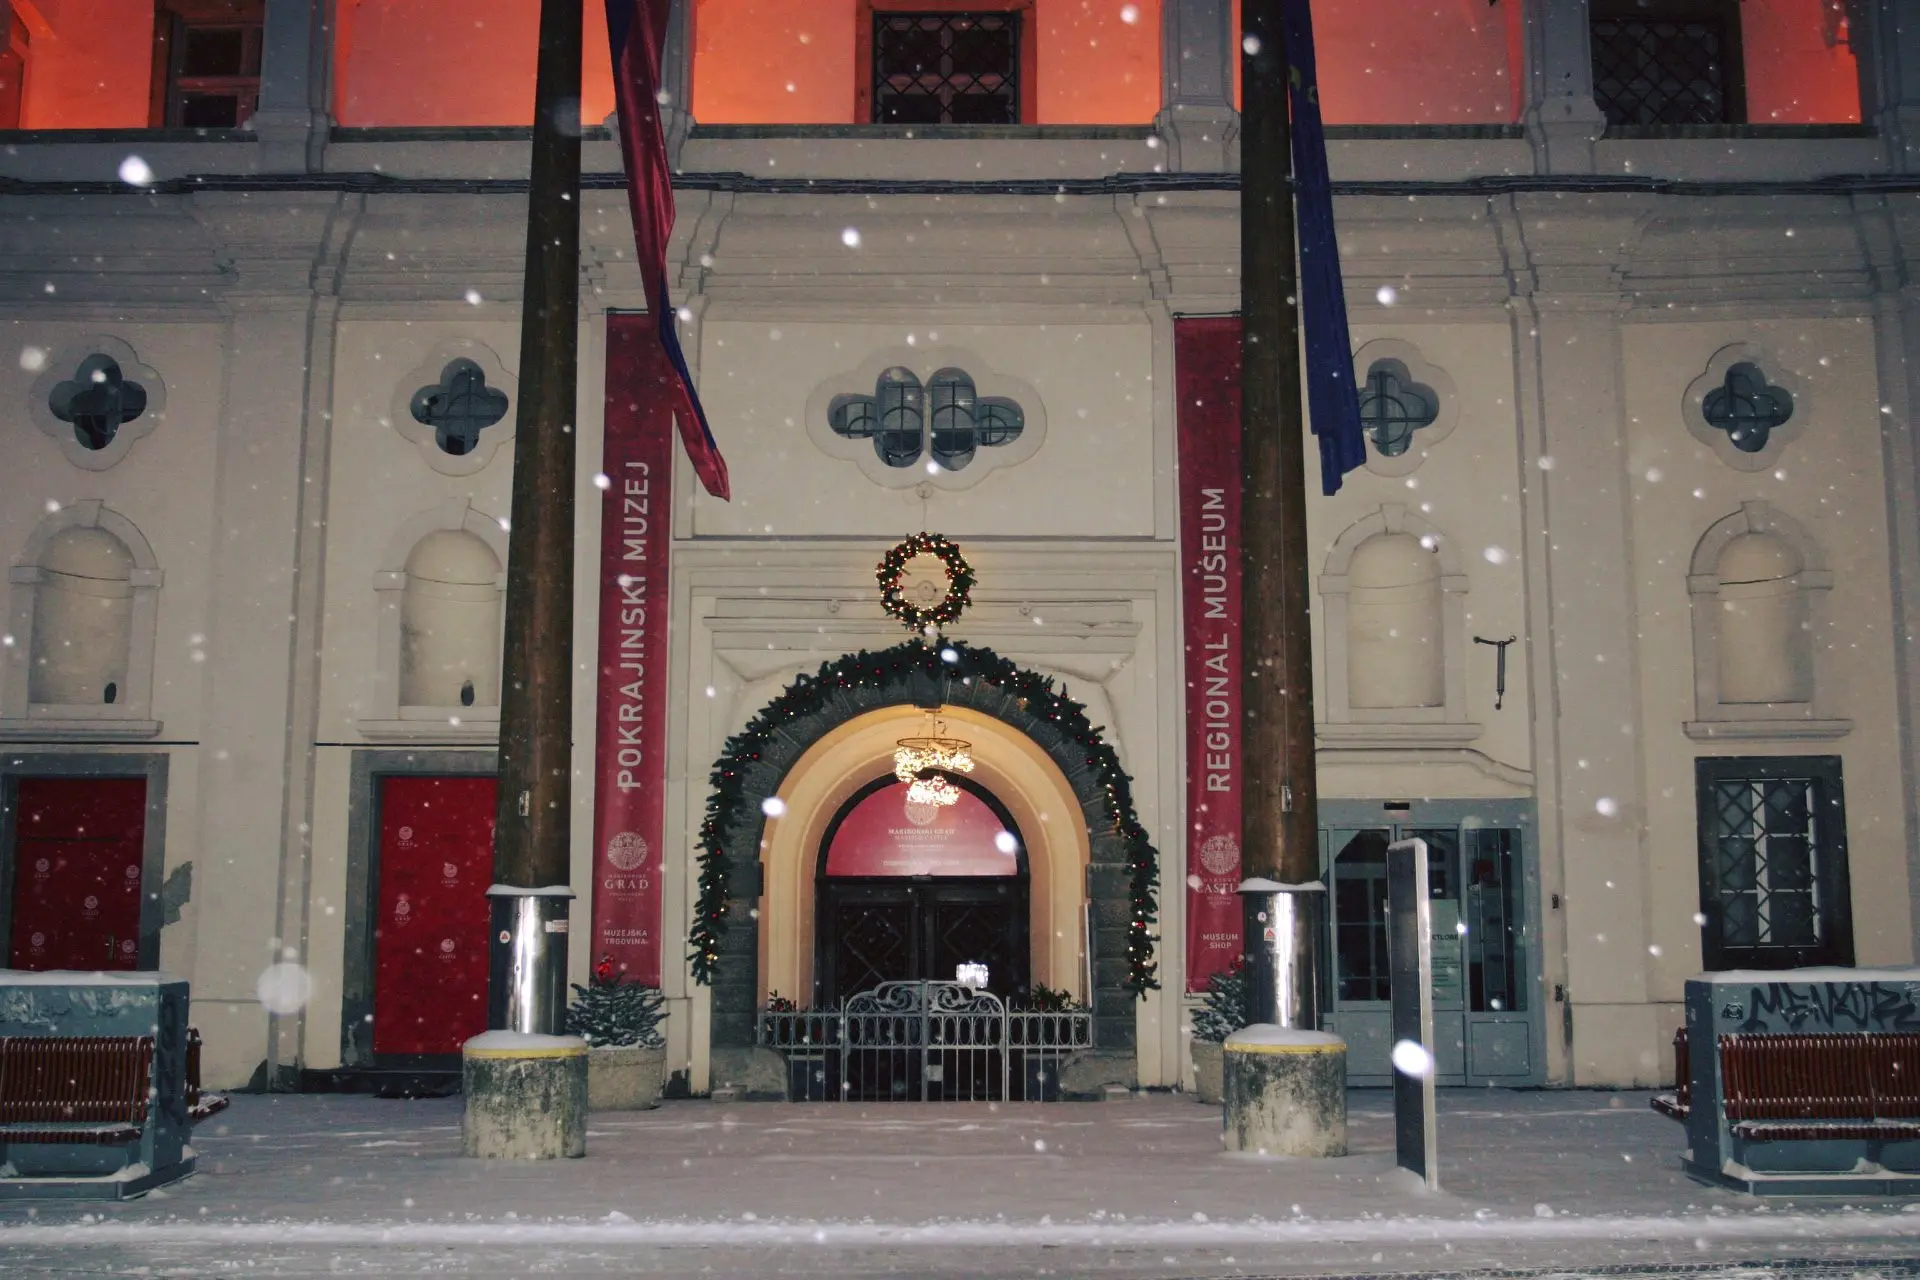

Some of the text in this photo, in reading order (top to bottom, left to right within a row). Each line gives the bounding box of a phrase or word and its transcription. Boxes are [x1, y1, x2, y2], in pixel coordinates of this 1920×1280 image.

[617, 461, 649, 789] POKRAJINSKI MUZEJ
[1202, 487, 1230, 792] REGIONAL MUSEUM
[604, 879, 649, 890] GRAD
[603, 929, 648, 937] MUZEJSKA
[1202, 933, 1238, 941] MUSEUM
